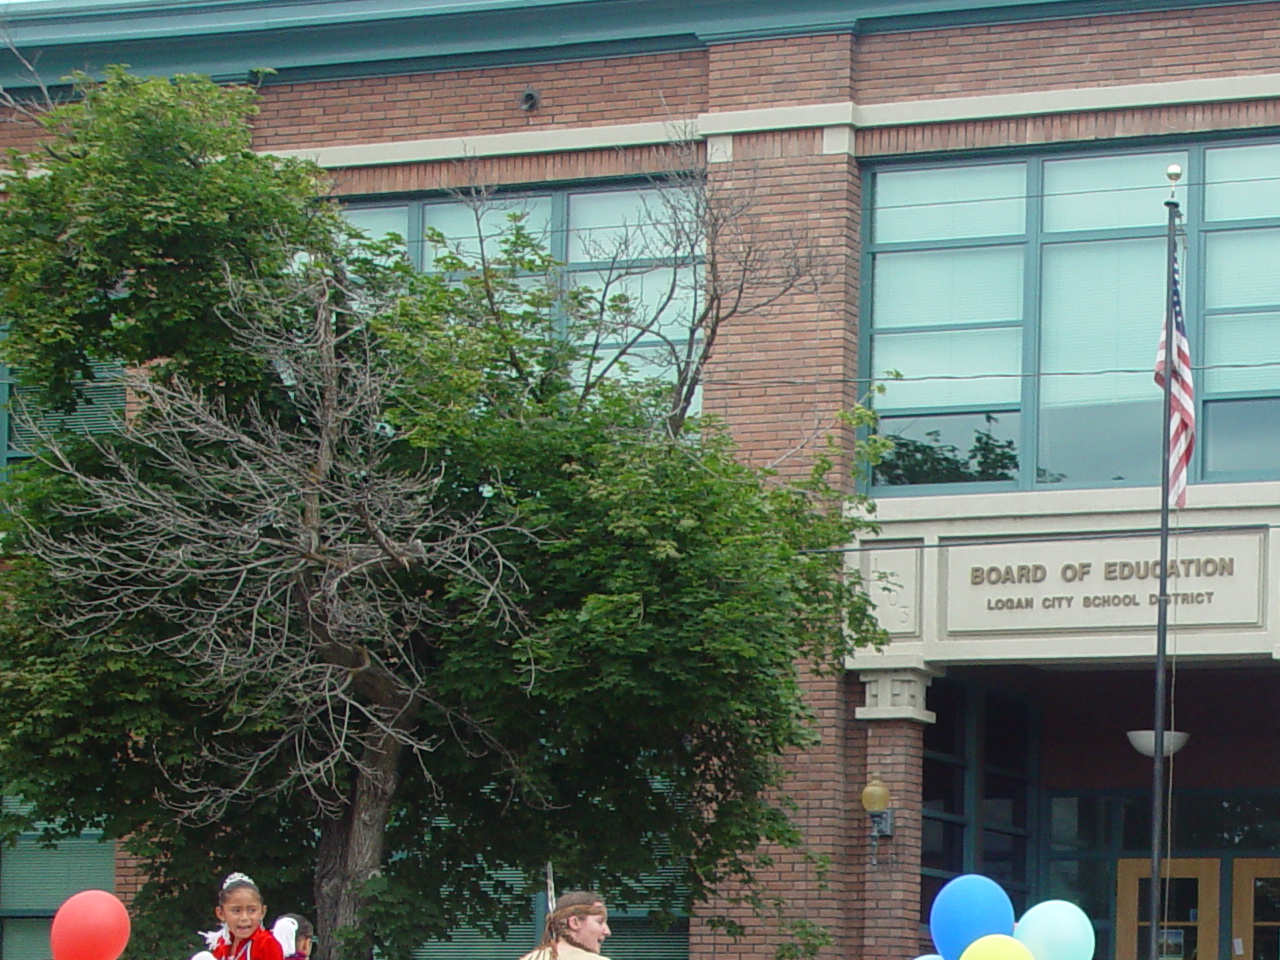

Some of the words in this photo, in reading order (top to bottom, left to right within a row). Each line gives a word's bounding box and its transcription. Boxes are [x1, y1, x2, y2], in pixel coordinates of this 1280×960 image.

[970, 564, 1047, 585] BOARD
[1061, 562, 1092, 582] OF
[1104, 557, 1234, 580] EDUCATION
[987, 597, 1034, 610] LOGAN
[1041, 596, 1074, 609] CITY
[1083, 595, 1141, 608] SCHOOL
[1149, 592, 1214, 606] DSTRICT
